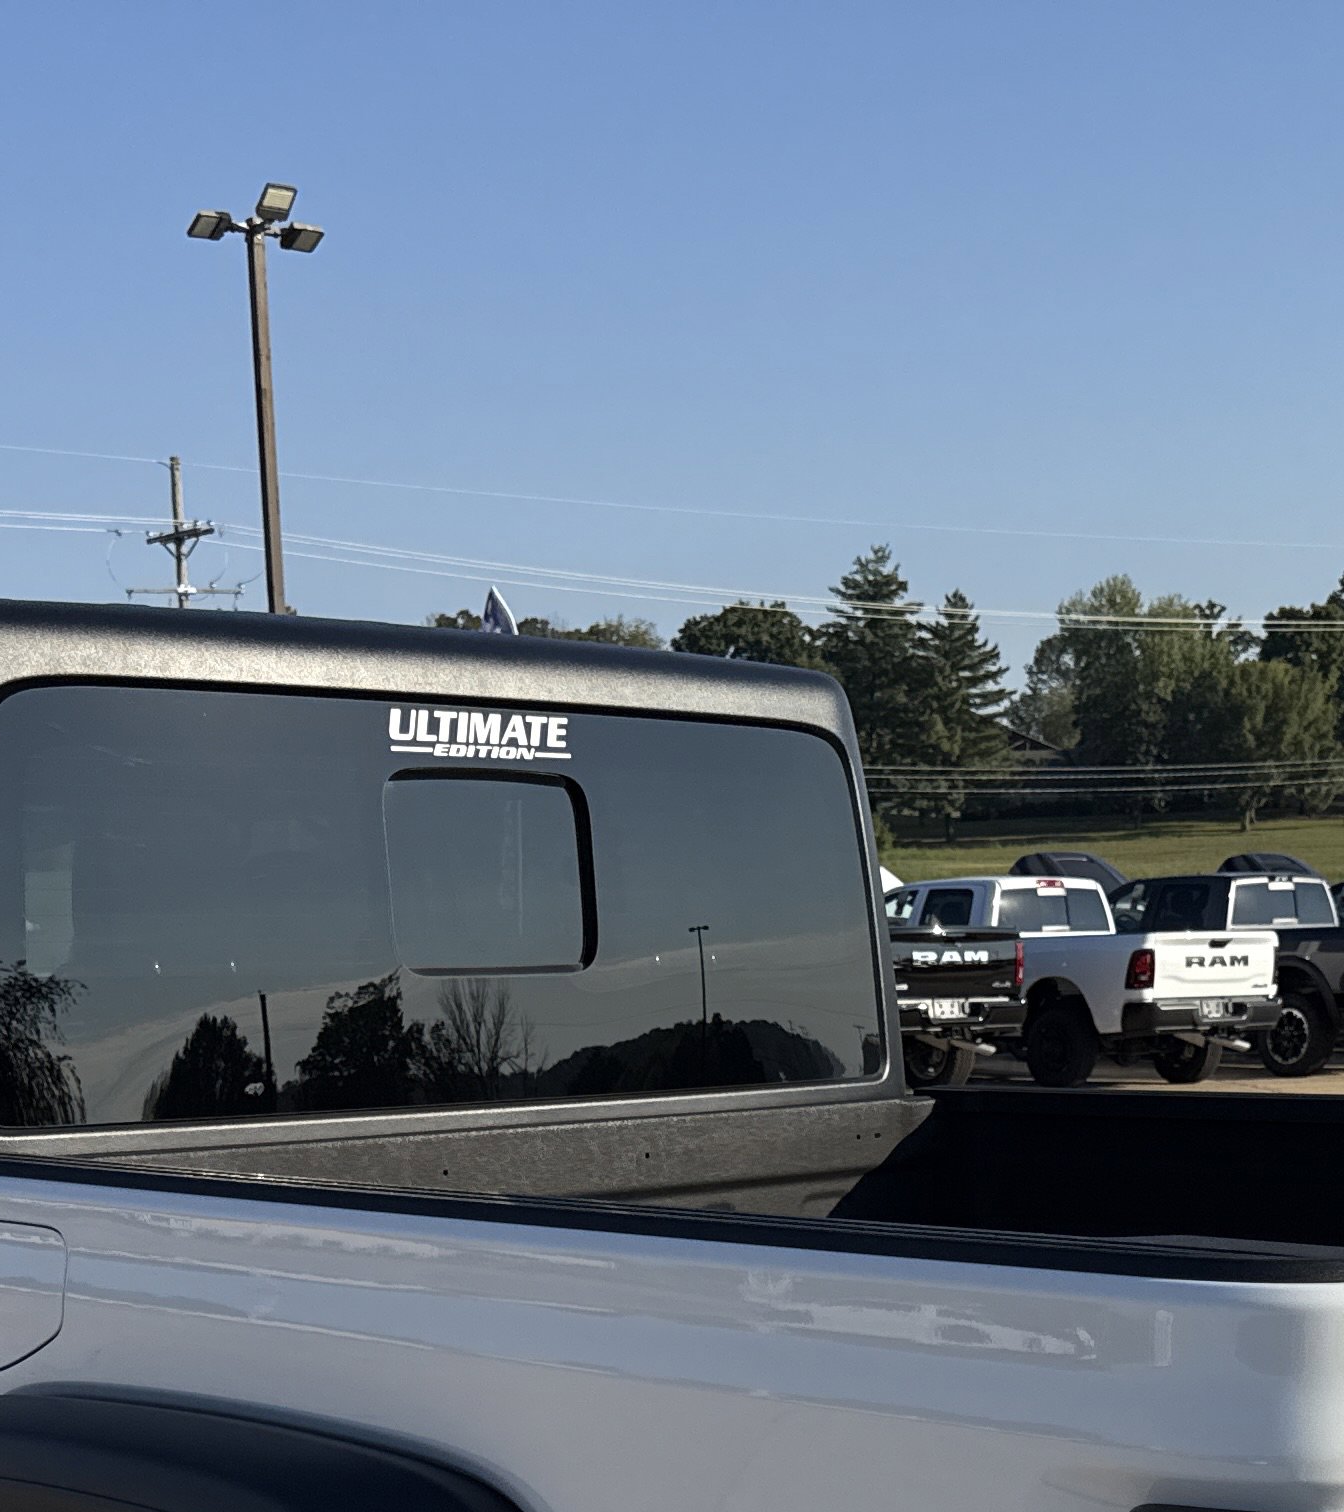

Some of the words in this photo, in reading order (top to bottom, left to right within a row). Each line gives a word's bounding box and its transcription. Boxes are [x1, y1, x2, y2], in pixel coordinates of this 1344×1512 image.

[388, 707, 569, 748] ULTIMATE
[433, 743, 536, 760] EDITION
[912, 951, 989, 966] RAM
[1185, 955, 1249, 967] RAM
